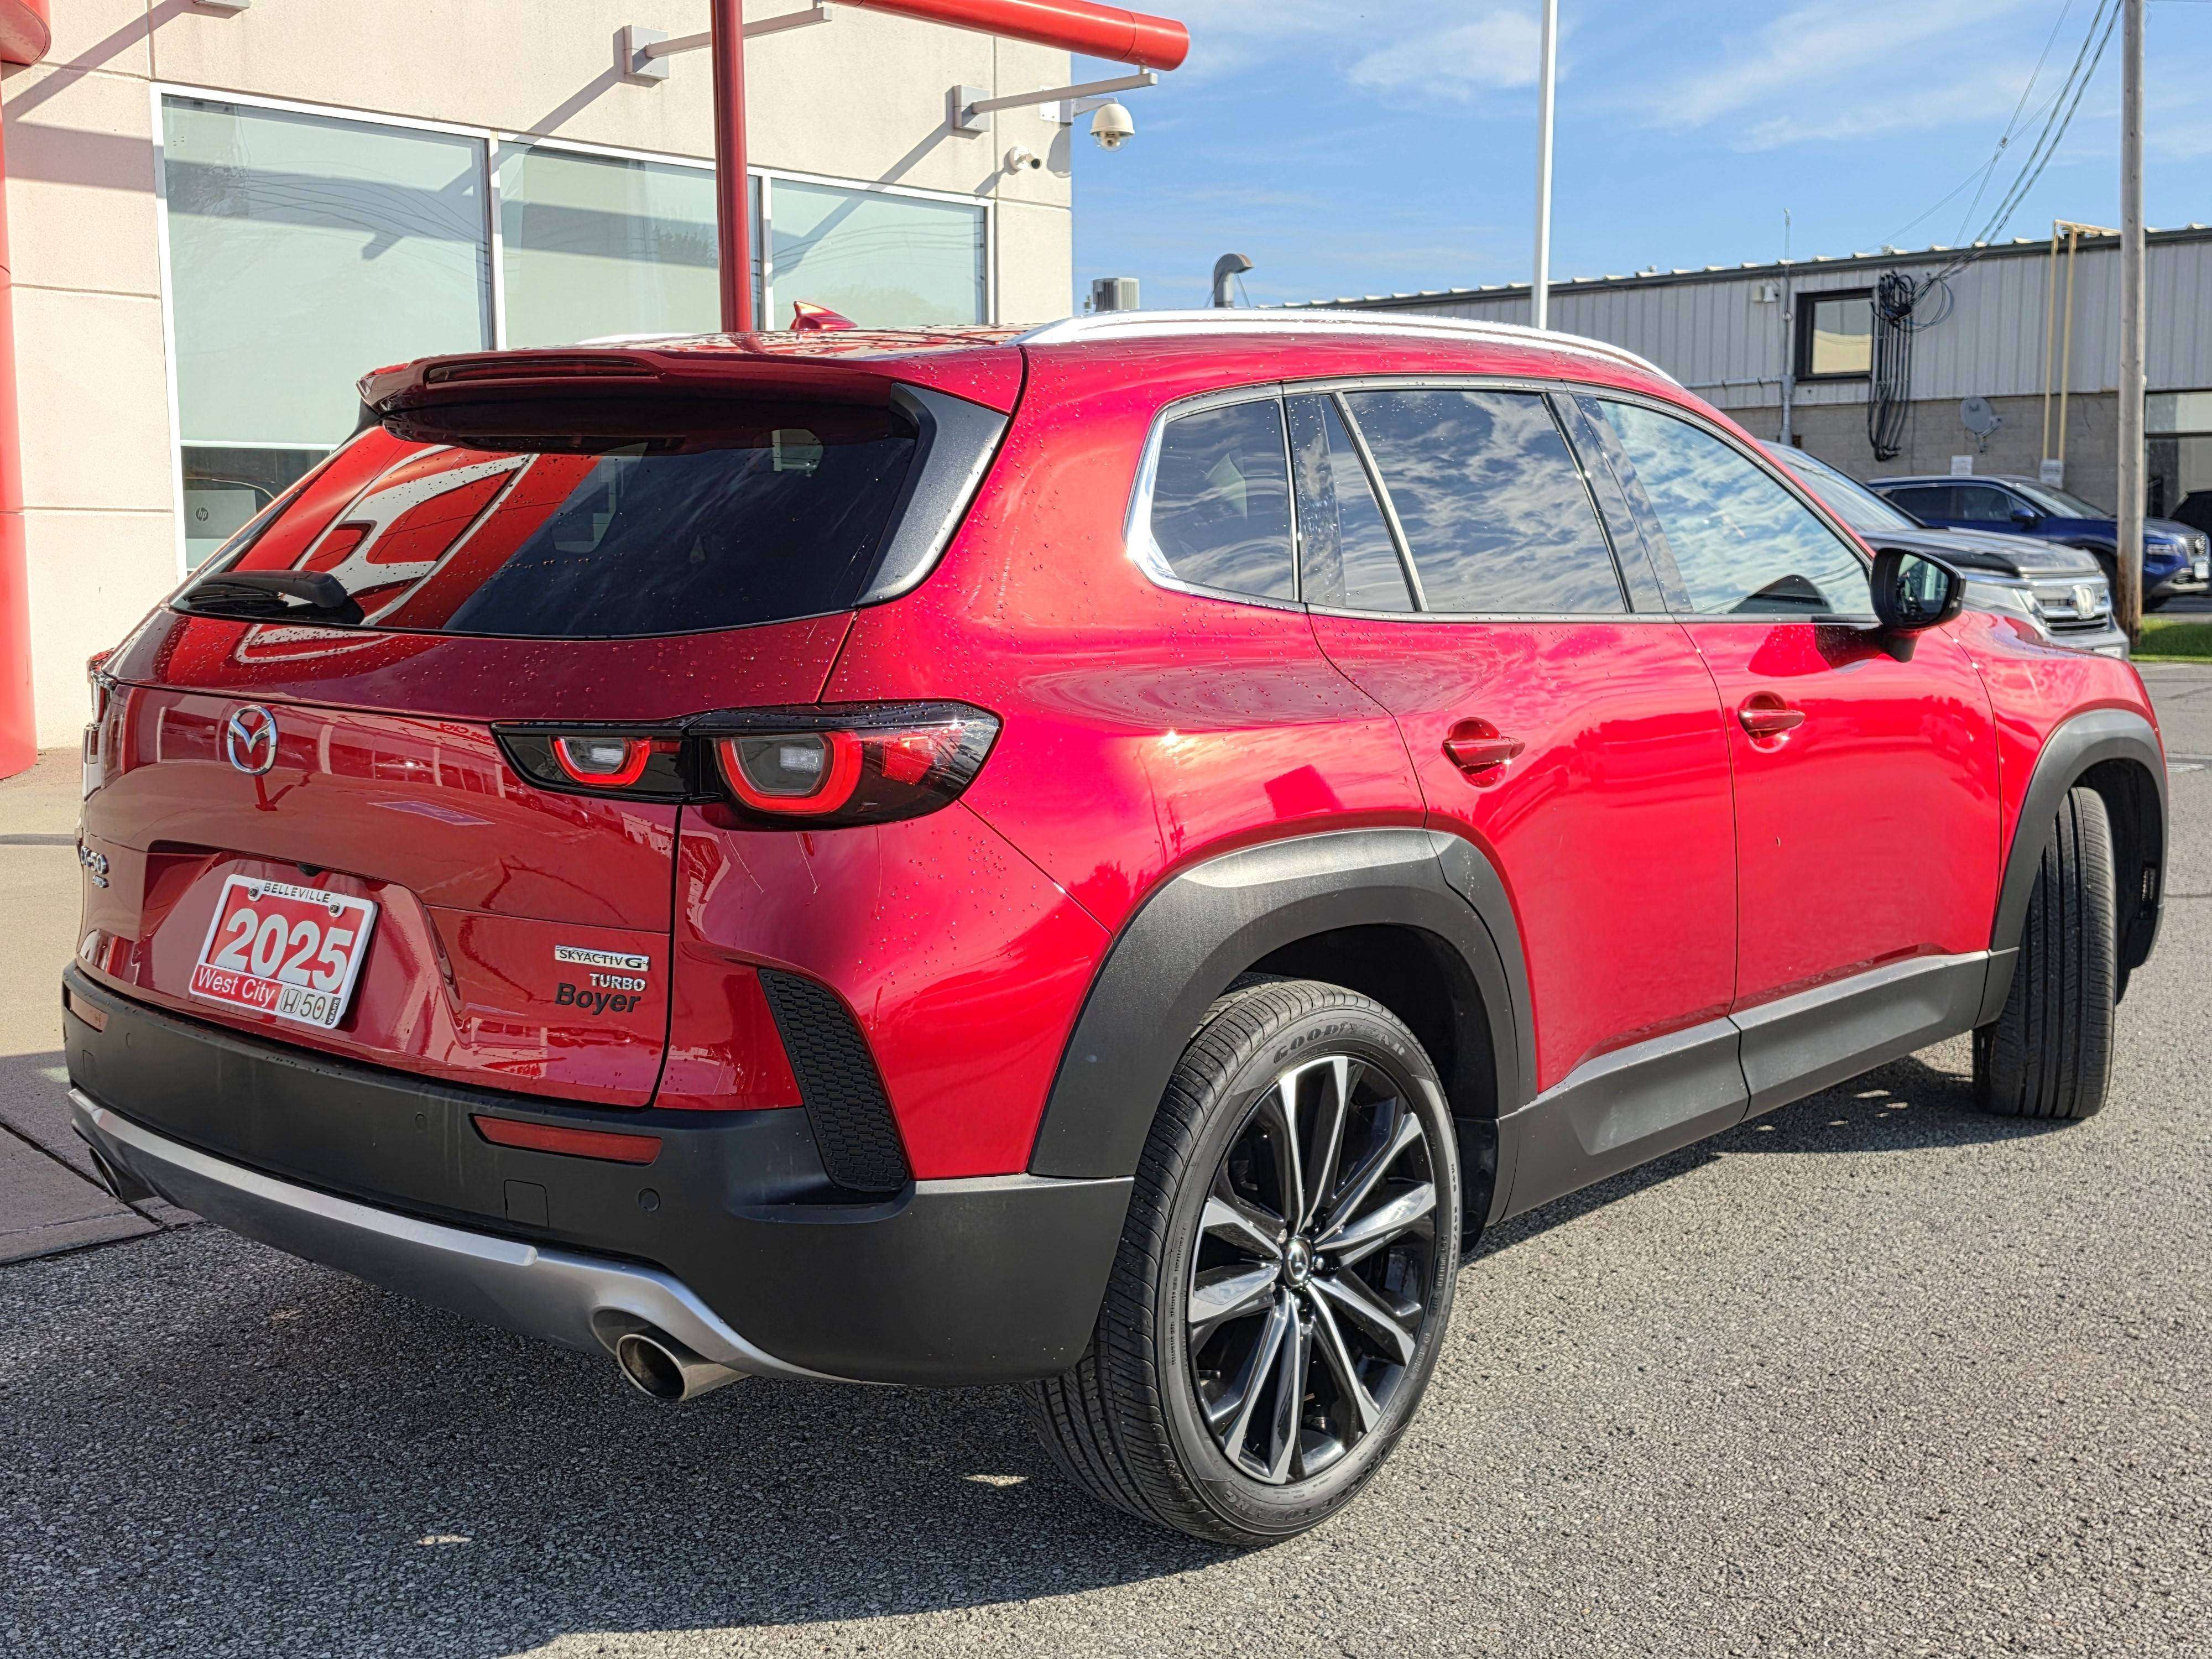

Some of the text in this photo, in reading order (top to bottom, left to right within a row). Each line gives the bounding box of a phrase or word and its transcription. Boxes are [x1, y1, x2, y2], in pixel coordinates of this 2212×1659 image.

[264, 882, 331, 903] BELLEVILLE
[215, 908, 354, 993] 2025
[198, 967, 275, 1007] West City
[589, 973, 646, 992] TURBO
[300, 994, 326, 1020] 50
[327, 999, 340, 1024] YEARS
[555, 983, 641, 1015] Boyer
